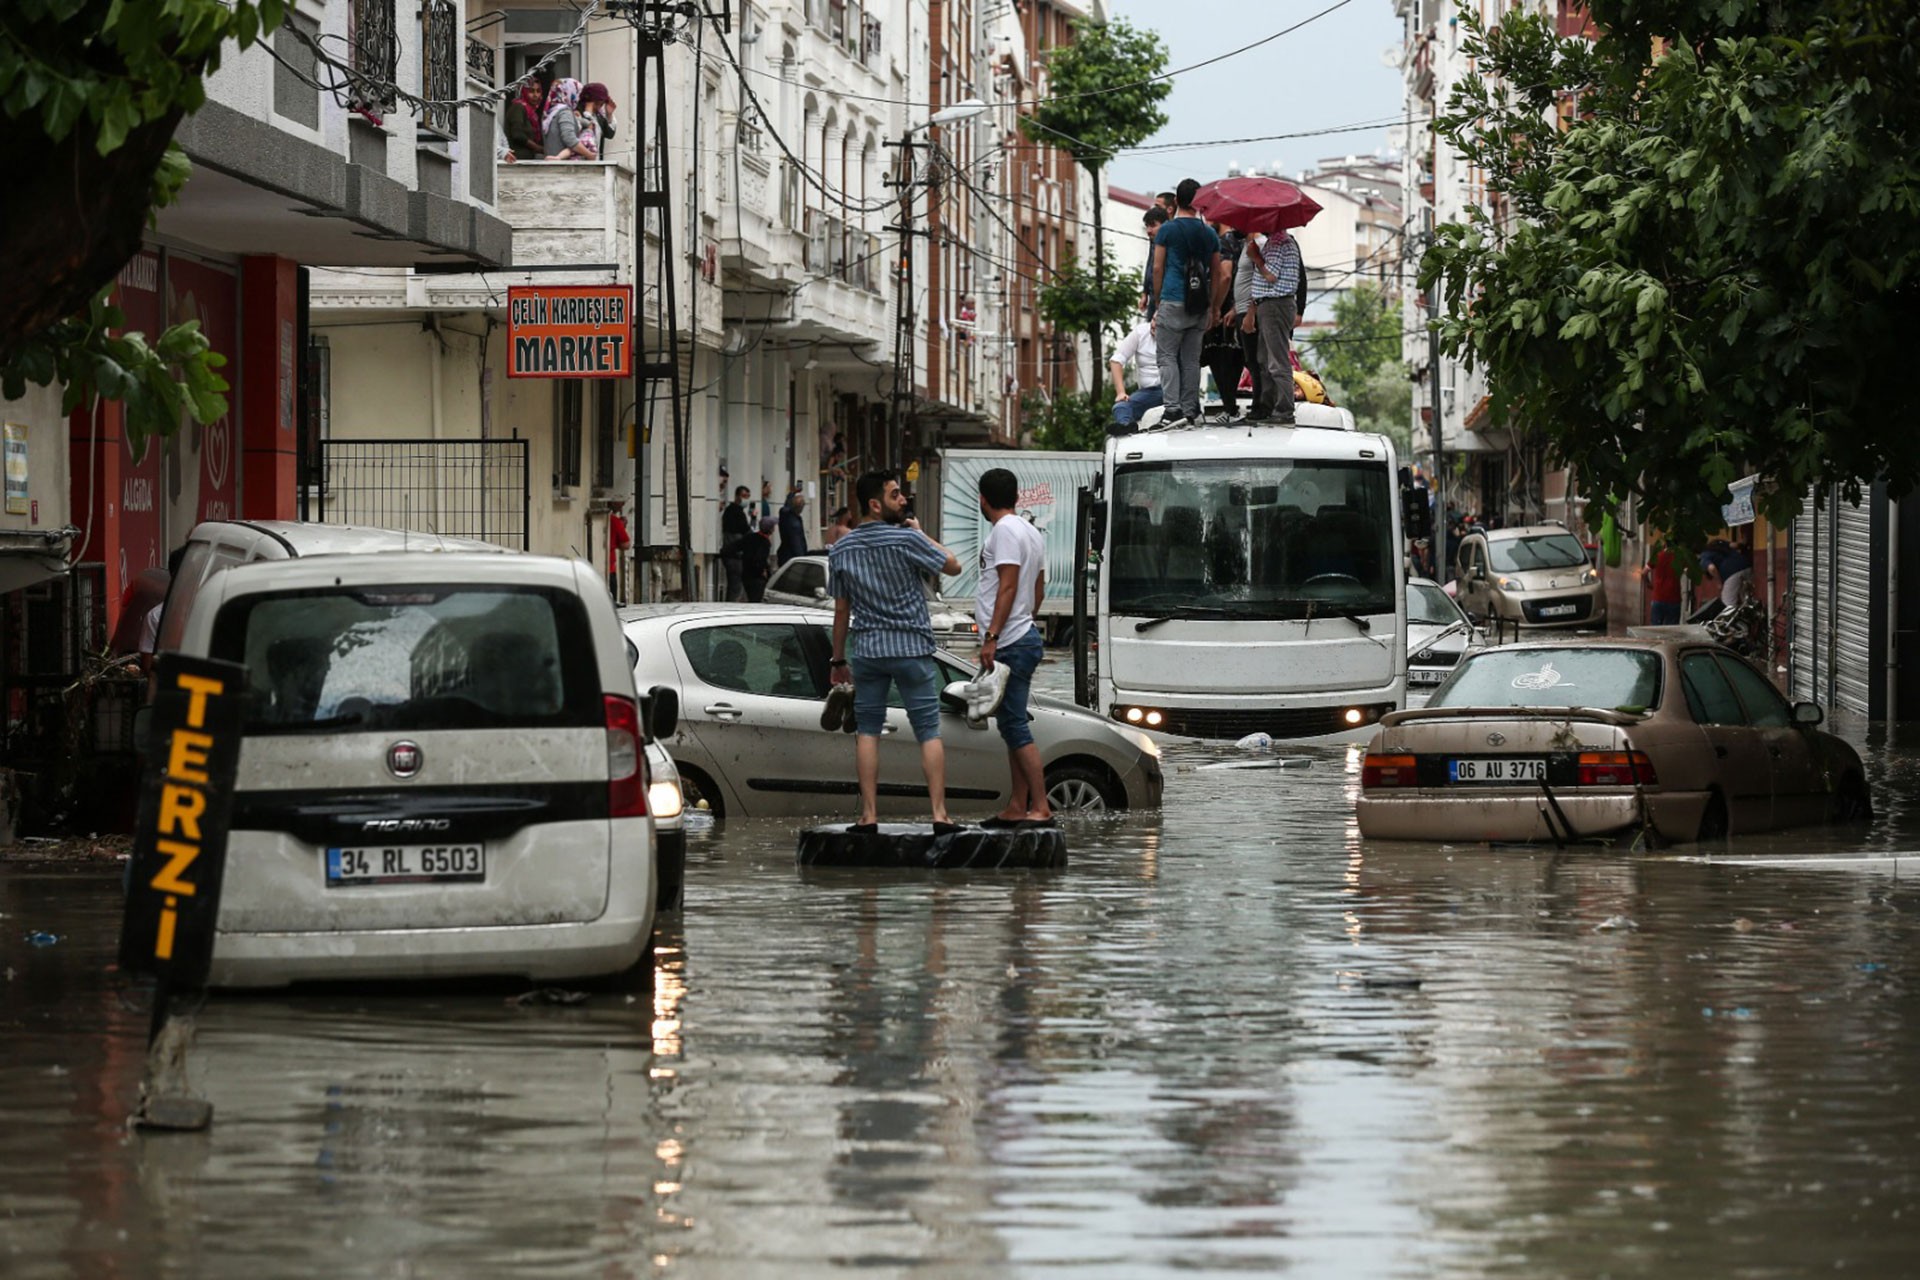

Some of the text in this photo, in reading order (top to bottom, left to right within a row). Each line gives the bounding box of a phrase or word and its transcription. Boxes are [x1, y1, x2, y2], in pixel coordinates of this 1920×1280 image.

[512, 292, 625, 331] ÇELİK KARDEŞLER
[515, 335, 624, 373] MARKET
[1458, 761, 1546, 779] 06 AU 3716
[362, 819, 450, 831] FIORINO
[341, 848, 479, 875] 34 RL 6503
